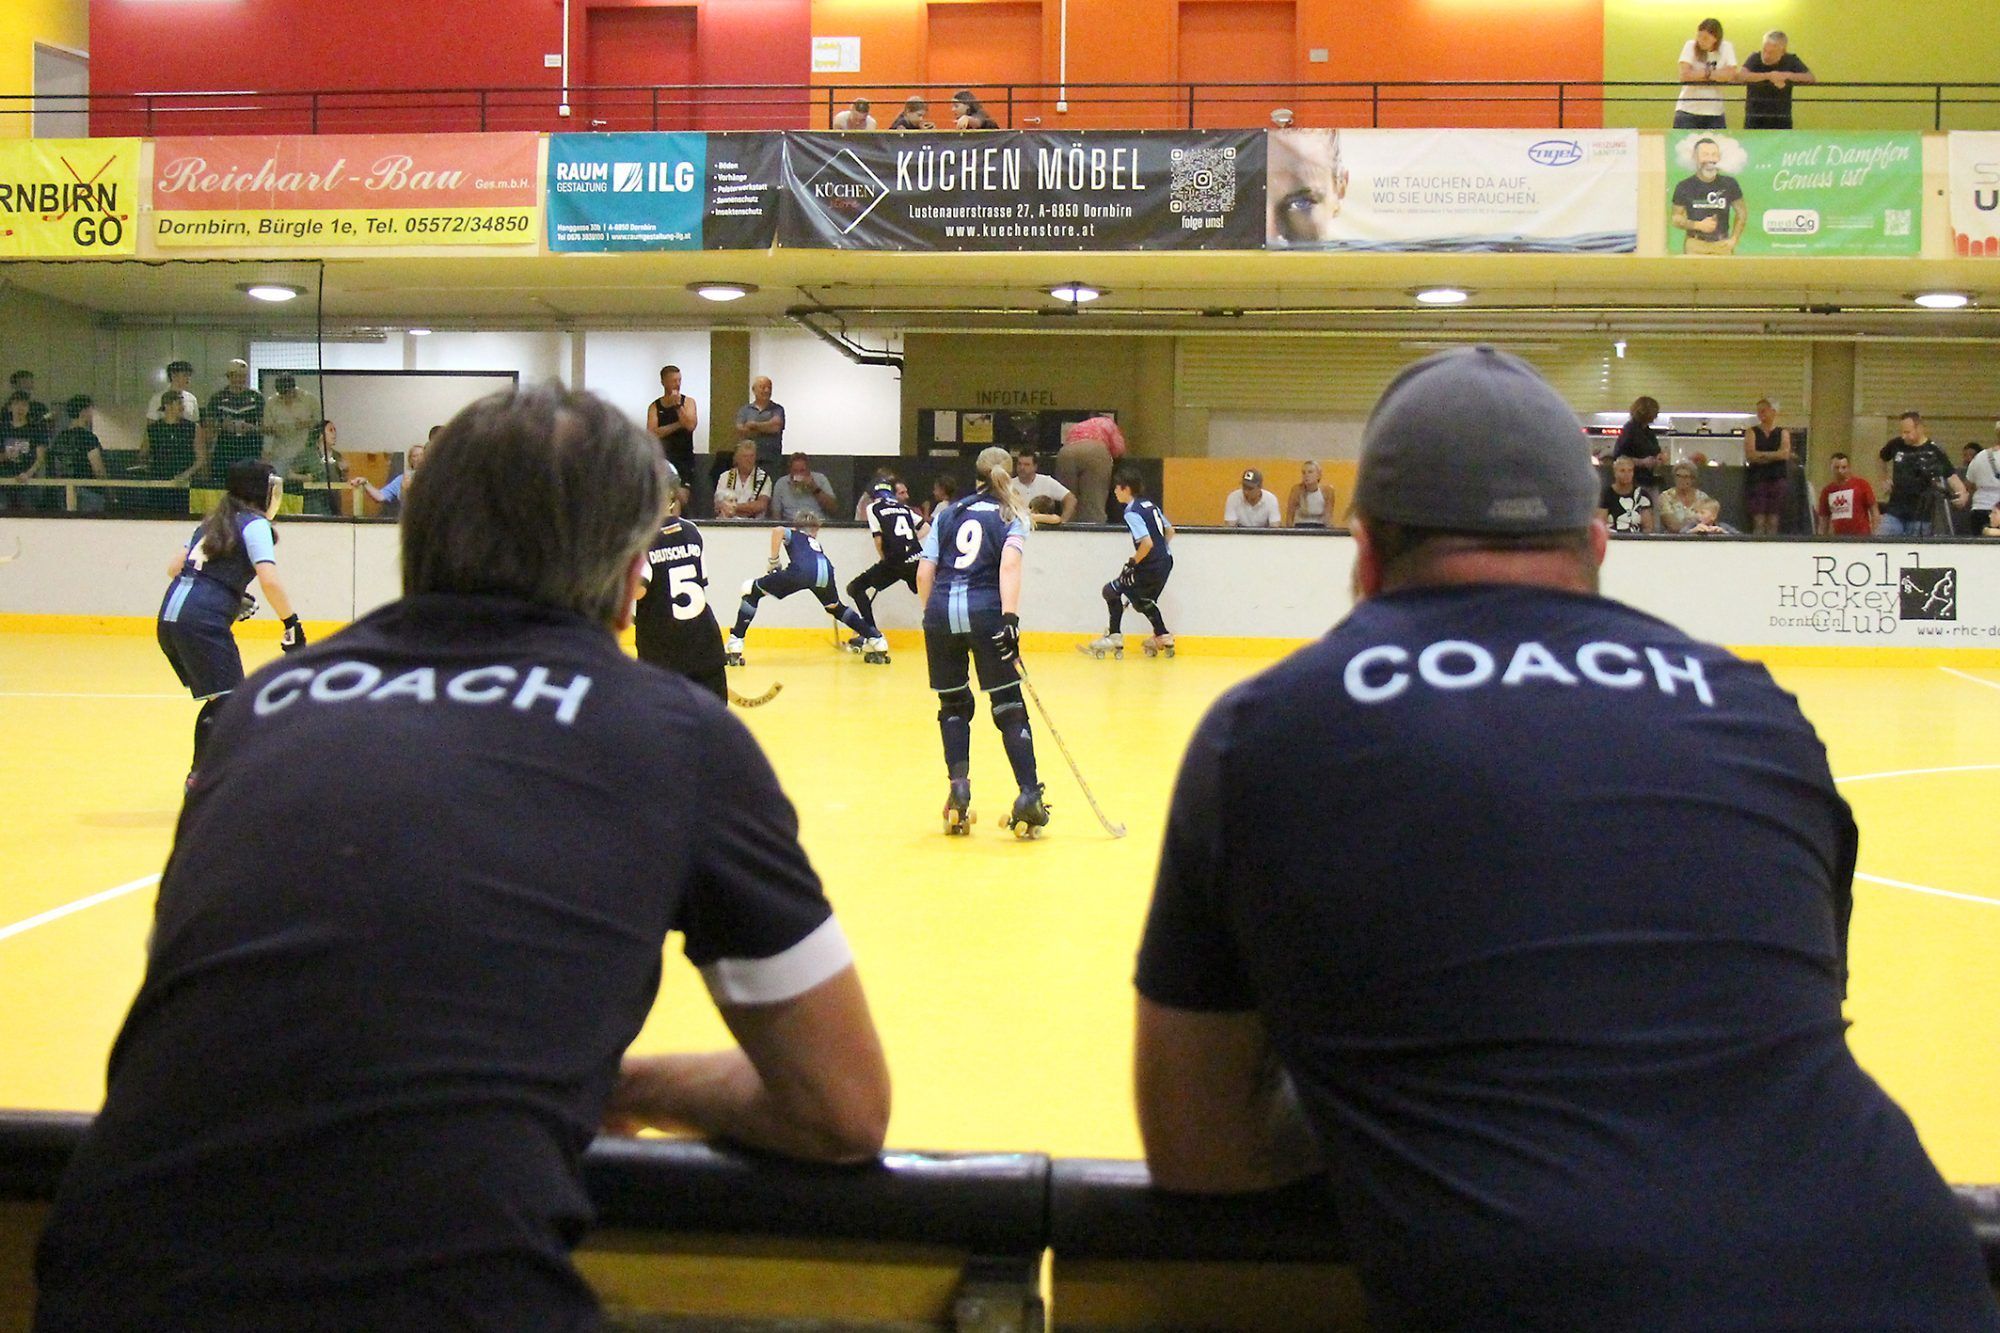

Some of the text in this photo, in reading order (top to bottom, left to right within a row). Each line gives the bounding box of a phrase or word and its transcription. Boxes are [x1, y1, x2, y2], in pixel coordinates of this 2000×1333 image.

[896, 143, 1146, 191] KÜCHEN MÖBEL
[1782, 145, 1822, 167] weil
[1826, 140, 1910, 170] Dampfen
[557, 162, 608, 181] RAUM
[650, 162, 694, 192] ILG
[1373, 176, 1400, 189] WIR
[1405, 176, 1471, 189] TAUCHEN
[1475, 176, 1495, 189] DA
[1772, 169, 1833, 192] Genuss
[557, 182, 607, 193] GESTALTUNG
[815, 182, 875, 198] KÜCHEN
[1373, 192, 1395, 204] WO
[1399, 192, 1421, 204] SIE
[1424, 192, 1454, 204] UNS
[909, 204, 1012, 219] Lustenauerstrasse
[1038, 204, 1079, 218] A-6850
[1083, 204, 1133, 218] Dornbirn
[1181, 214, 1224, 231] folge uns!
[73, 217, 123, 246] GO
[158, 215, 529, 238] Dornbirn, Bürgle 1e, Tel. 05572/34850
[945, 223, 1096, 238] www.kuechenstore.at
[976, 391, 1058, 406] INFOTAFEL
[894, 515, 914, 541] 4
[953, 518, 983, 570] 9
[668, 564, 707, 621] 5
[1778, 585, 1901, 613] Hockey
[1811, 607, 1897, 634] Club
[1342, 639, 1716, 707] COACH
[253, 660, 592, 726] COACH
